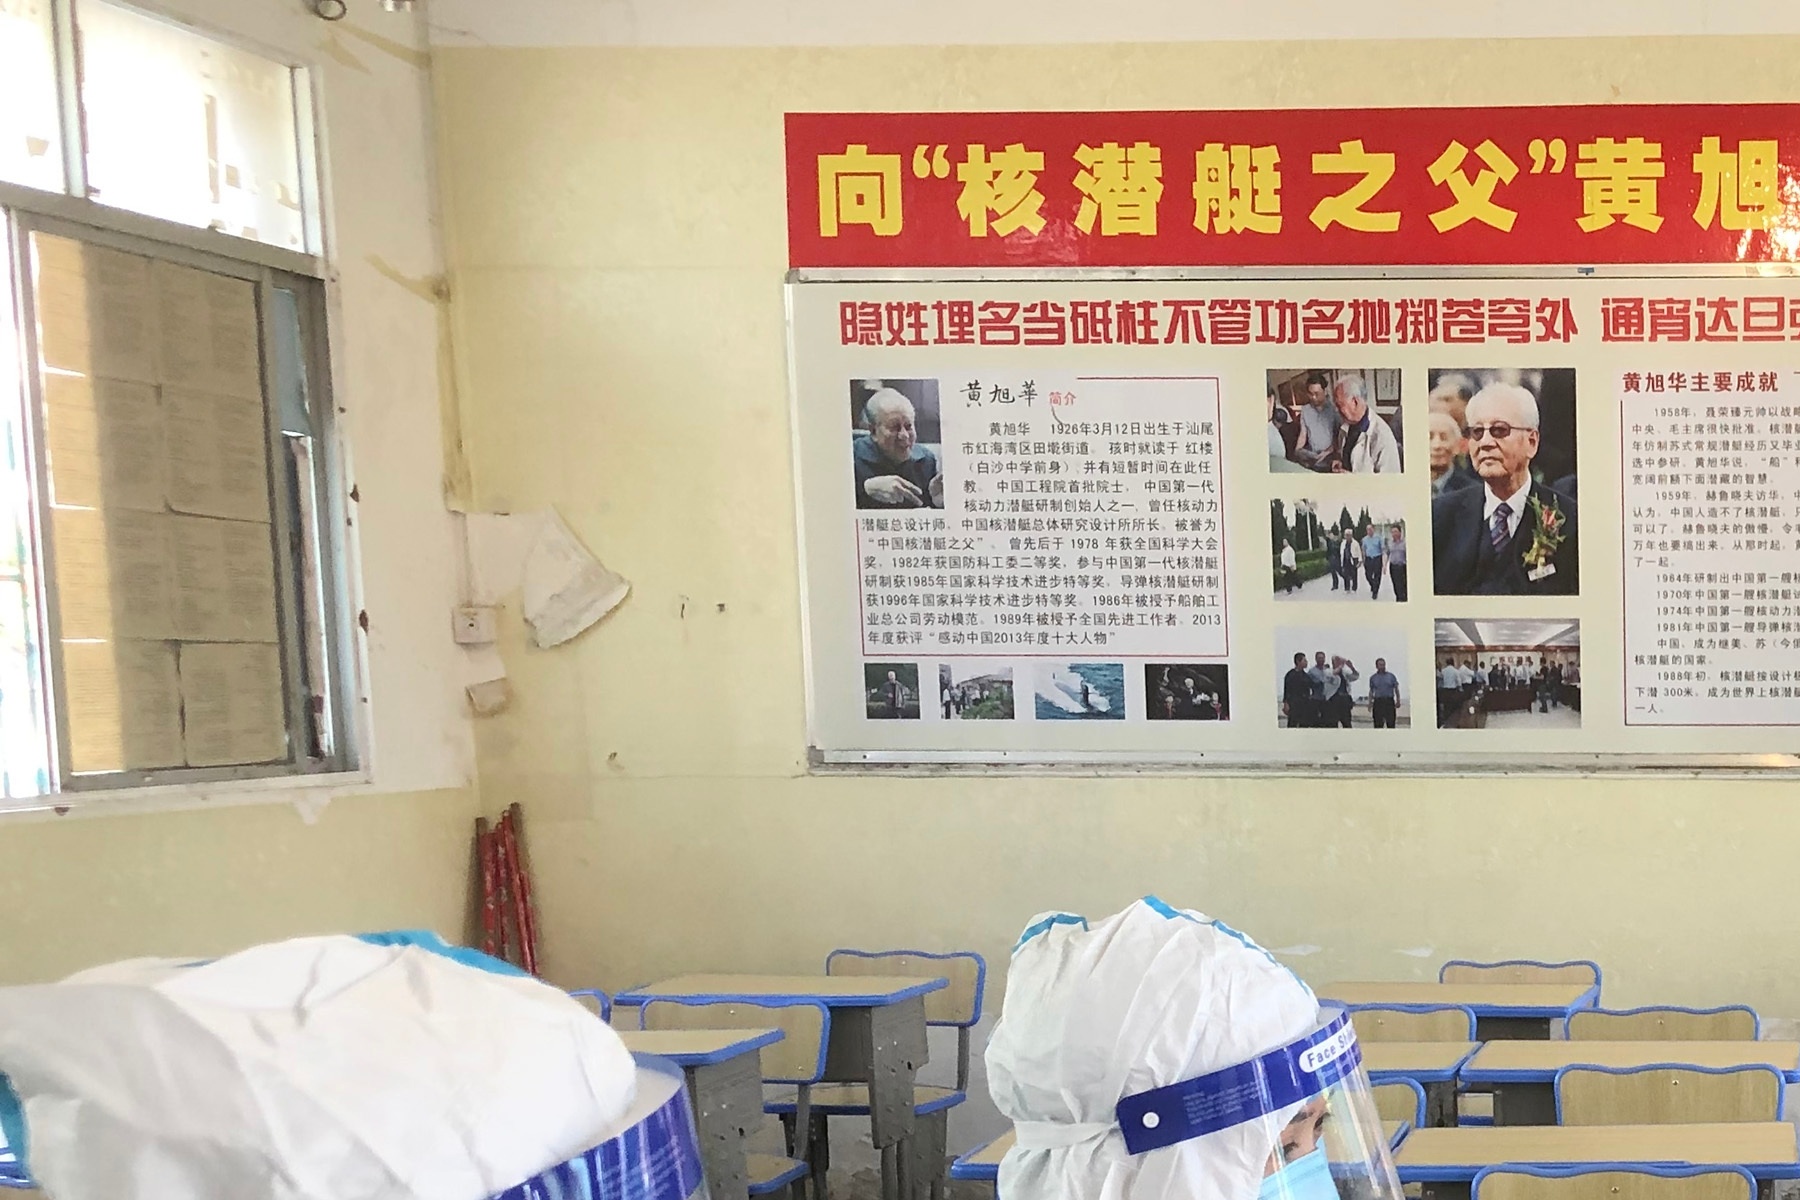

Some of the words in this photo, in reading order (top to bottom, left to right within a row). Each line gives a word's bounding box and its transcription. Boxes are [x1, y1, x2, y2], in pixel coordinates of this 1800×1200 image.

[840, 298, 1578, 346] 隐姓埋名当砥柱不管功名抛掷苍穹外
[1621, 371, 1779, 394] 黄旭华主要成就
[1049, 391, 1077, 407] 简介
[989, 422, 1031, 437] 黄旭华
[1050, 421, 1215, 437] 1926年3月12日出生于汕尾
[1307, 1045, 1336, 1067] Face
